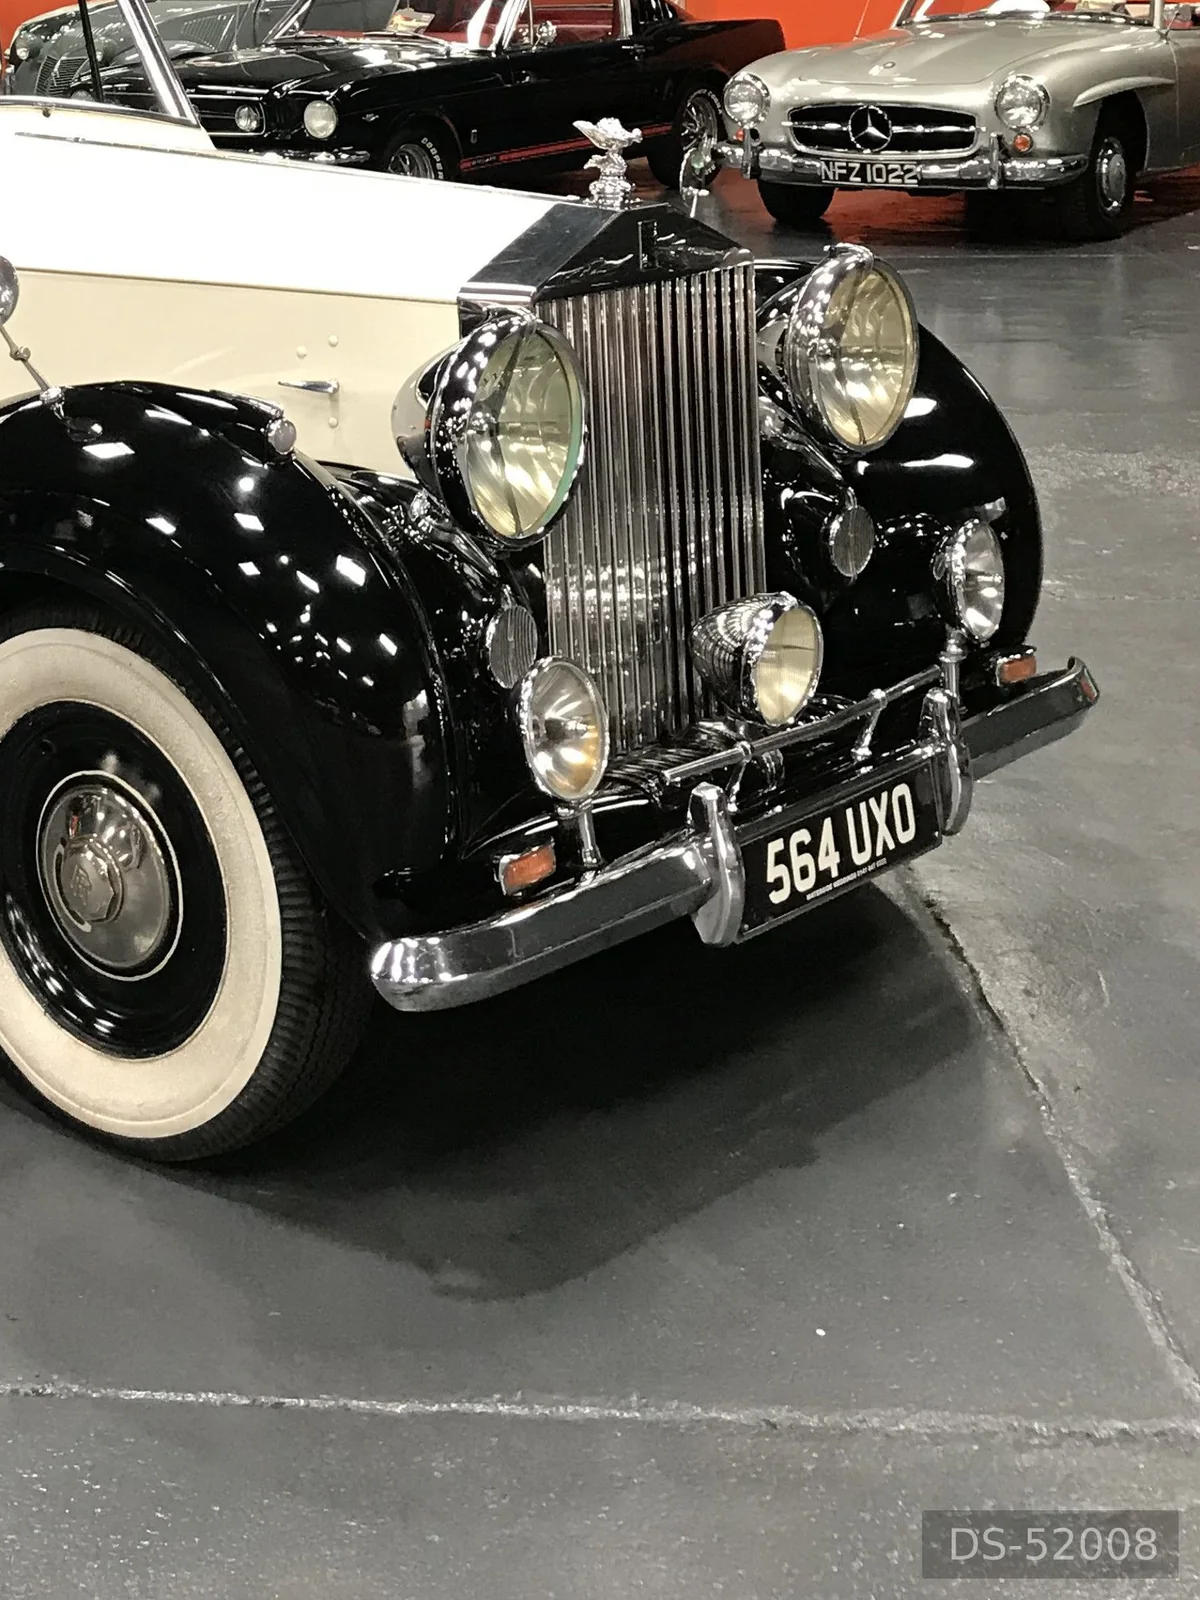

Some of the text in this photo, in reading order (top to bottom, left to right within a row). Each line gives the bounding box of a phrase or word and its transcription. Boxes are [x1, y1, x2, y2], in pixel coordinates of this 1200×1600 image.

[820, 161, 918, 184] NFZ 1022
[767, 783, 916, 904] 564 UXO
